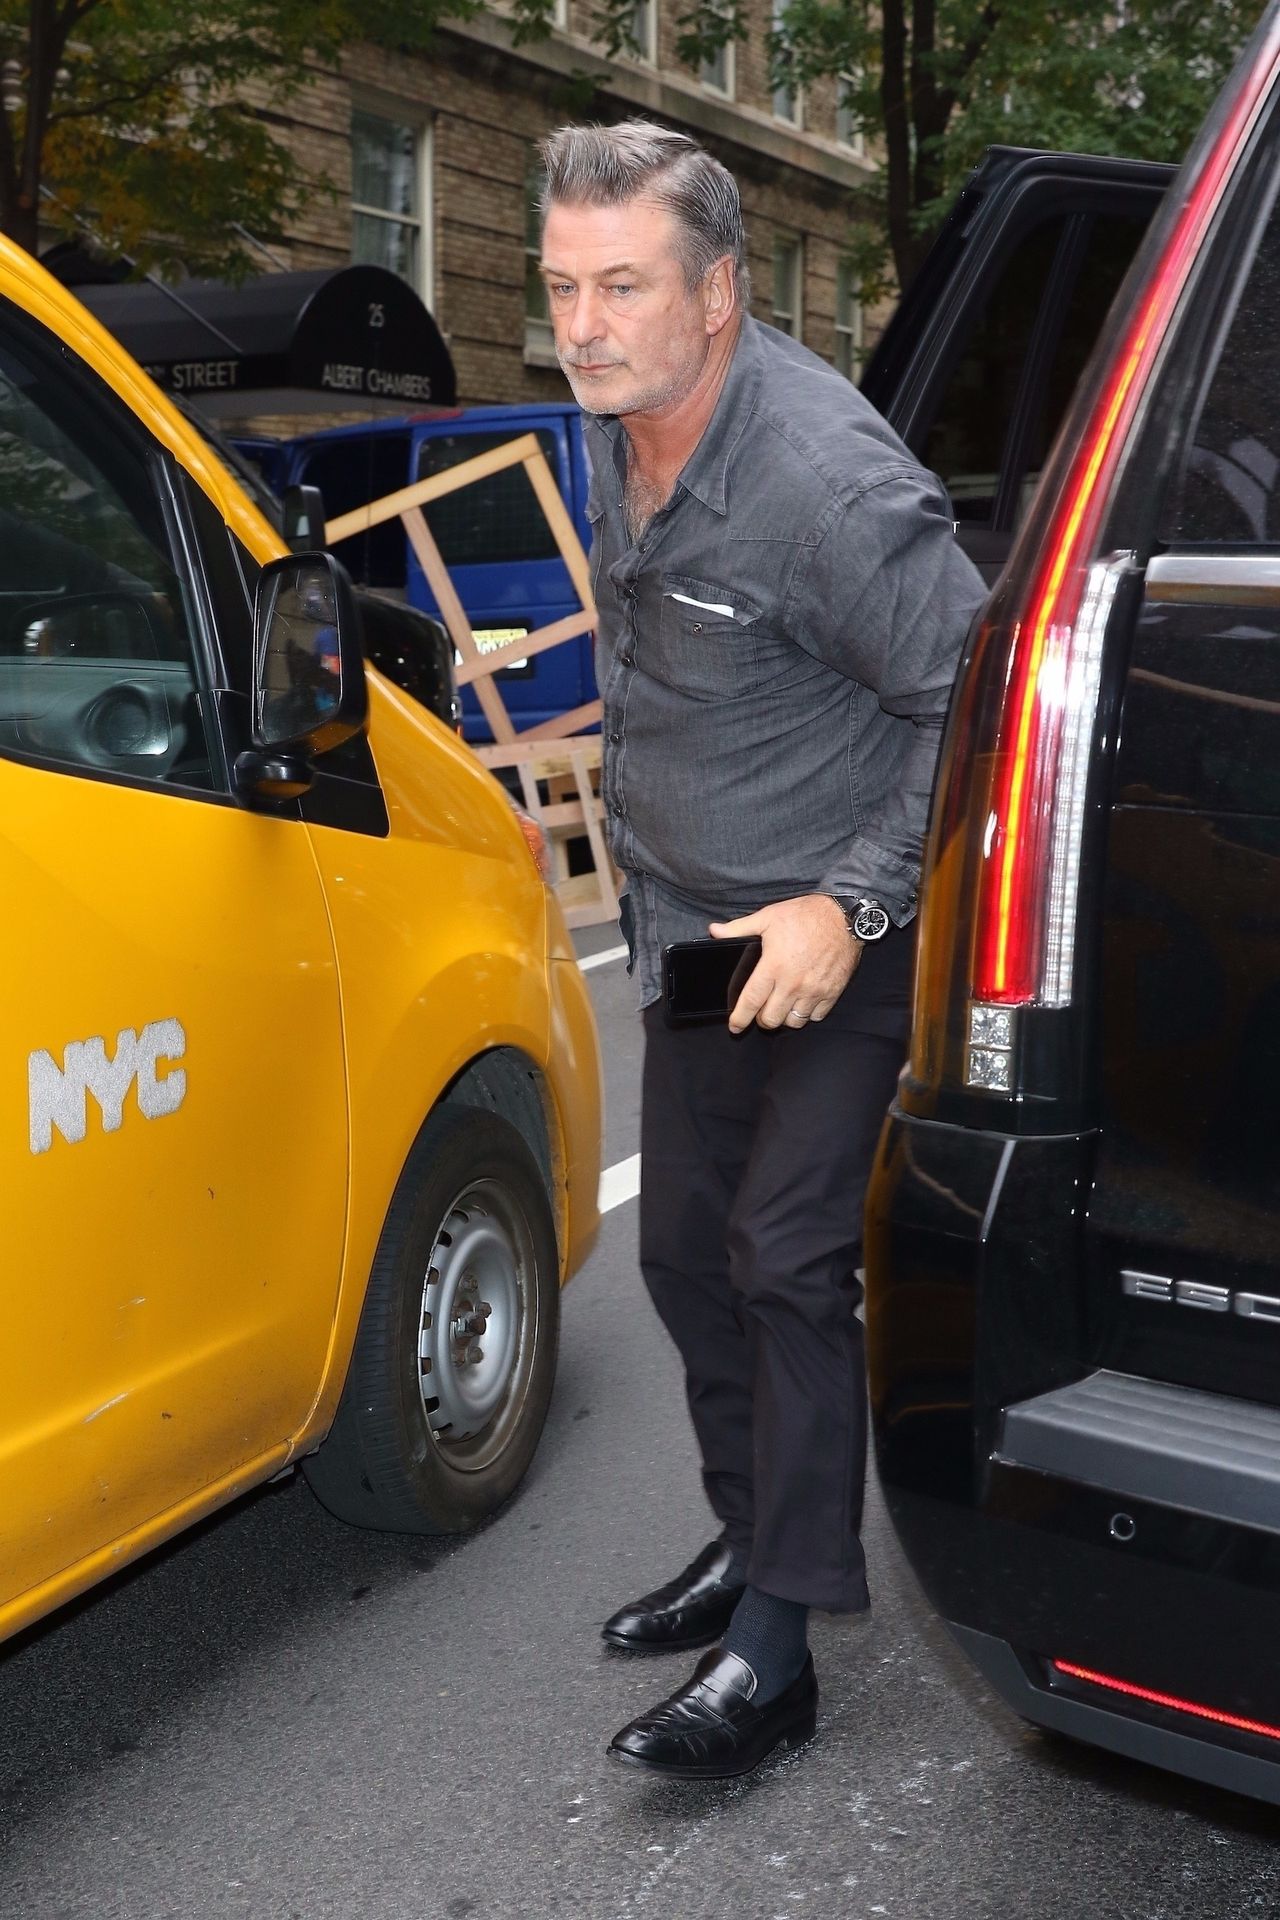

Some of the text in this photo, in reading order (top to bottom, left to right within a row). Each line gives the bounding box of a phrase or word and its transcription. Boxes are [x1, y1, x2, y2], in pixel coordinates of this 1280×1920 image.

[368, 303, 385, 328] 25
[172, 361, 239, 389] STREET
[321, 363, 432, 400] ALBERT CHAMBERS
[28, 1017, 188, 1156] NYC
